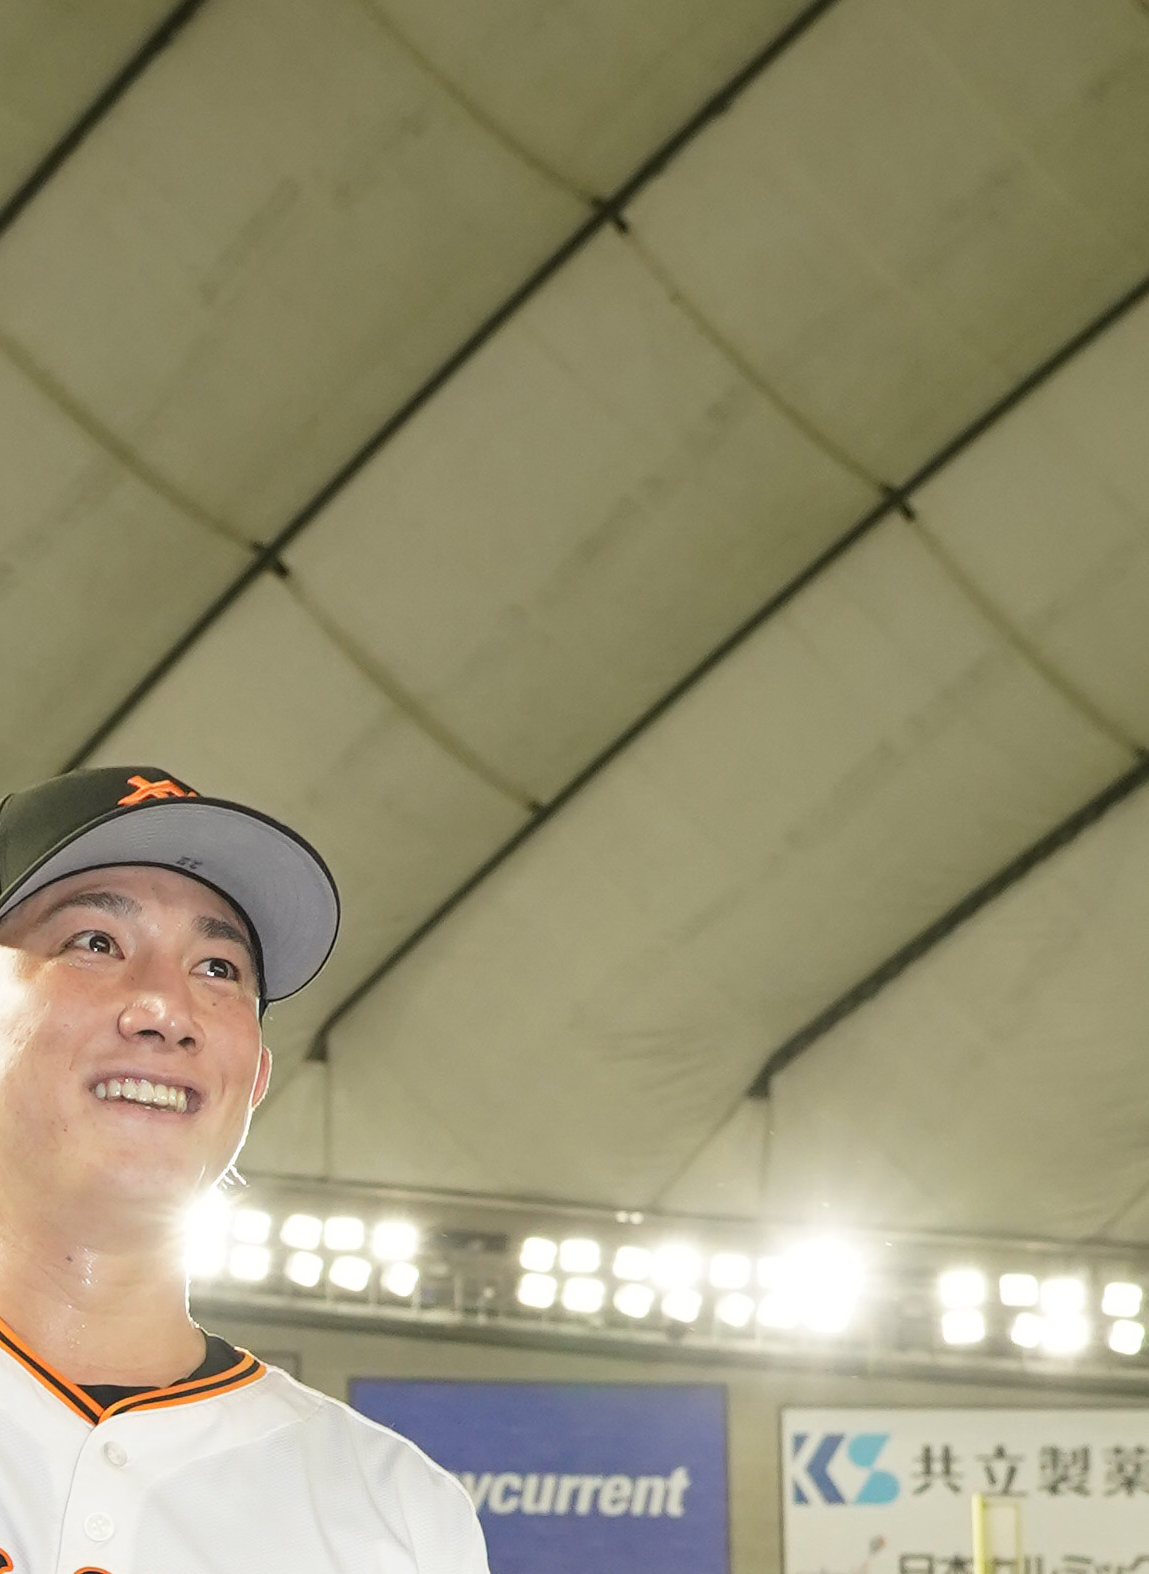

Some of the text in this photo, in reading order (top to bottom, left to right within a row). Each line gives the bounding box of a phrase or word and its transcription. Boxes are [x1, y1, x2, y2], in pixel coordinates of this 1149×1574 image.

[793, 1432, 901, 1506] KS
[911, 1443, 1149, 1498] 共立製薬
